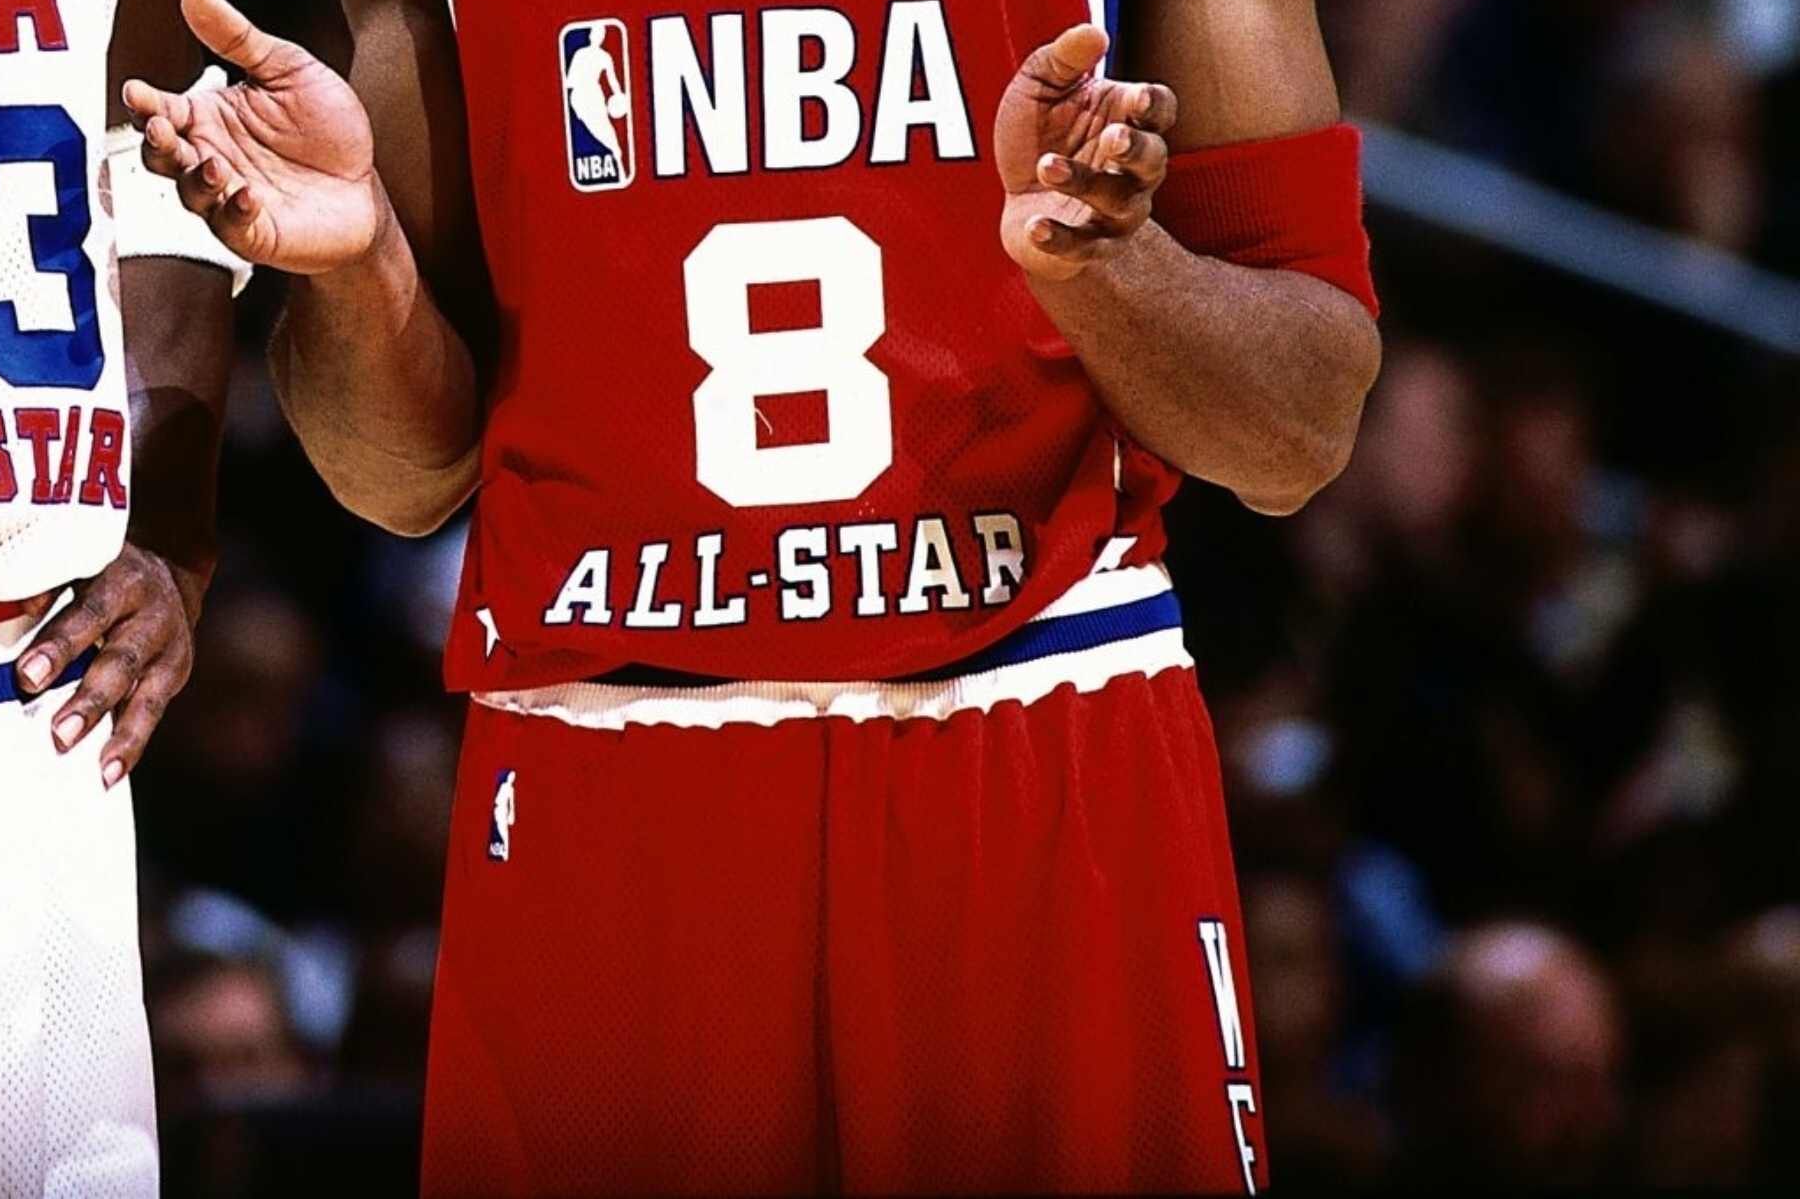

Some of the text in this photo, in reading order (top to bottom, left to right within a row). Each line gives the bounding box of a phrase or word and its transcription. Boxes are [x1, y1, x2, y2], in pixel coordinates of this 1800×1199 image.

[576, 154, 616, 180] NBA
[683, 216, 893, 507] 8
[542, 510, 1026, 628] ALL-STAR
